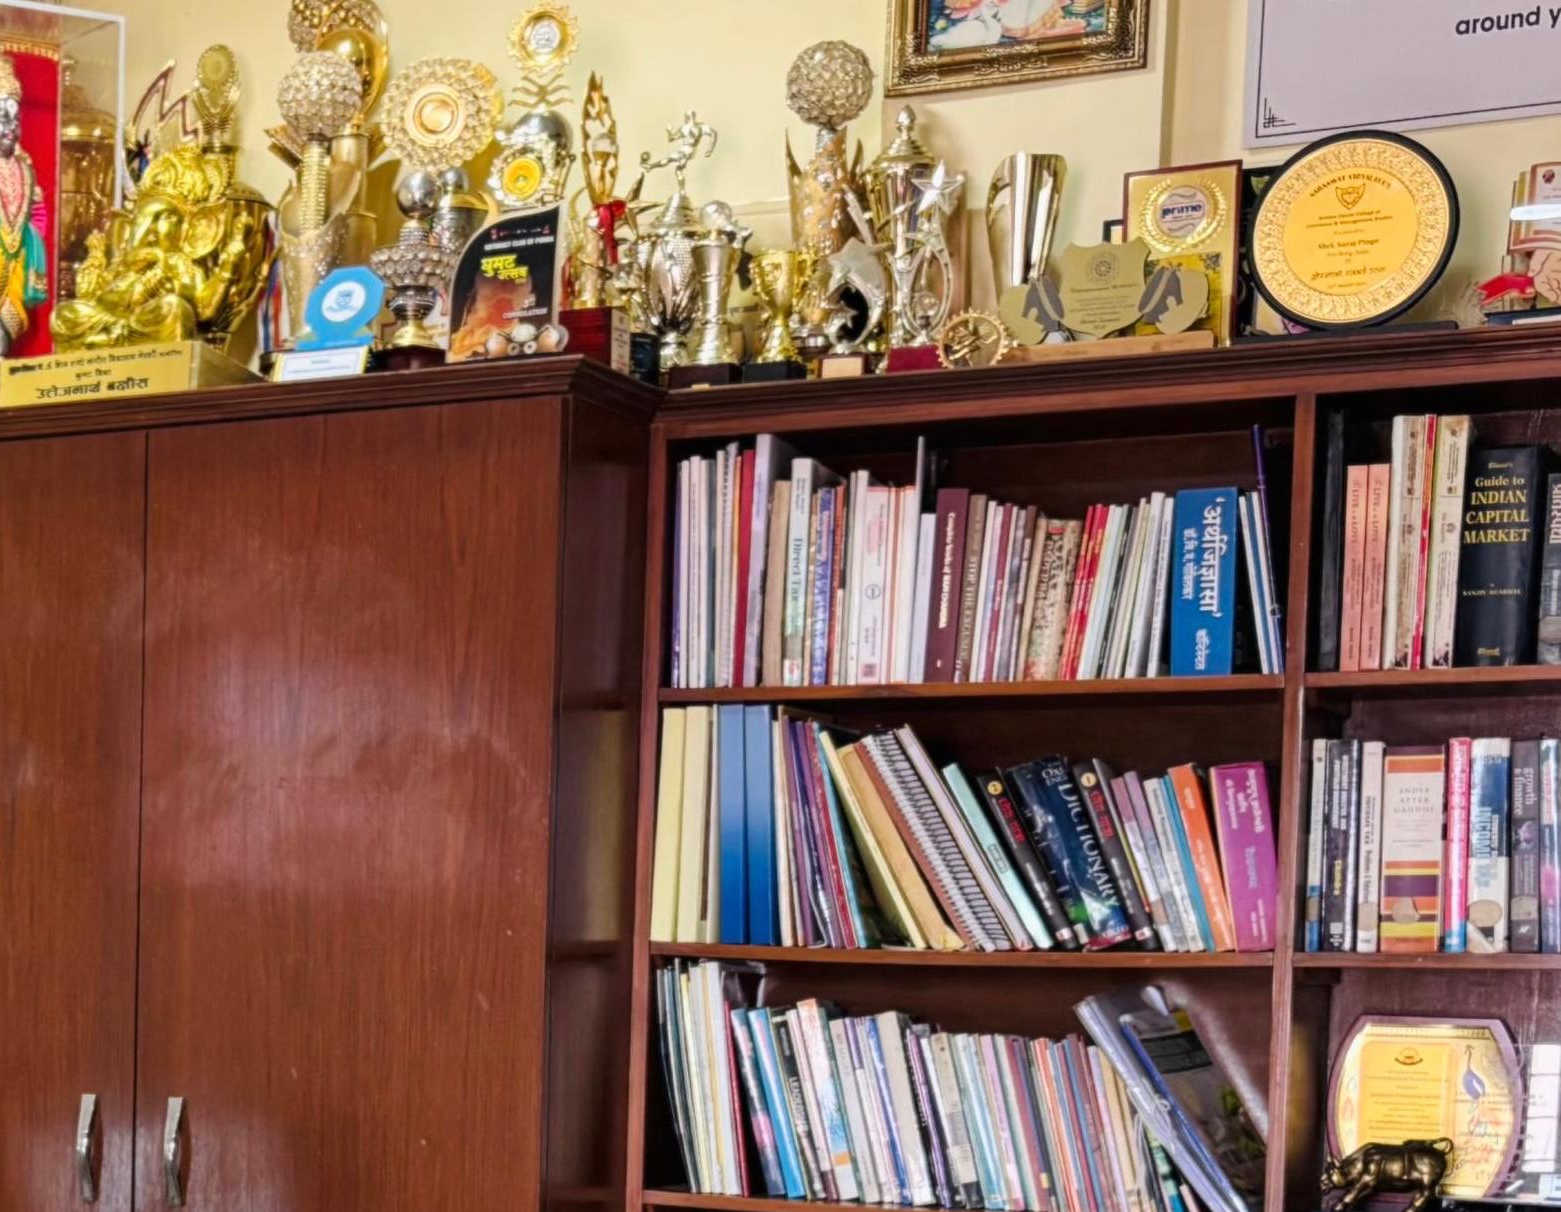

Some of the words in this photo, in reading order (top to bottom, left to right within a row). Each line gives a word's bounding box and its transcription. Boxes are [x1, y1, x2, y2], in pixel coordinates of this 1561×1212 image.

[1456, 5, 1541, 35] around
[1474, 475, 1510, 488] Guide
[1512, 476, 1525, 486] to
[1470, 489, 1527, 506] INDIAN
[1465, 510, 1530, 525] CAPITAL
[1463, 527, 1531, 545] MARKET
[1512, 777, 1524, 816] finance
[1522, 767, 1536, 806] growth
[1058, 782, 1121, 908] DICTIONARY
